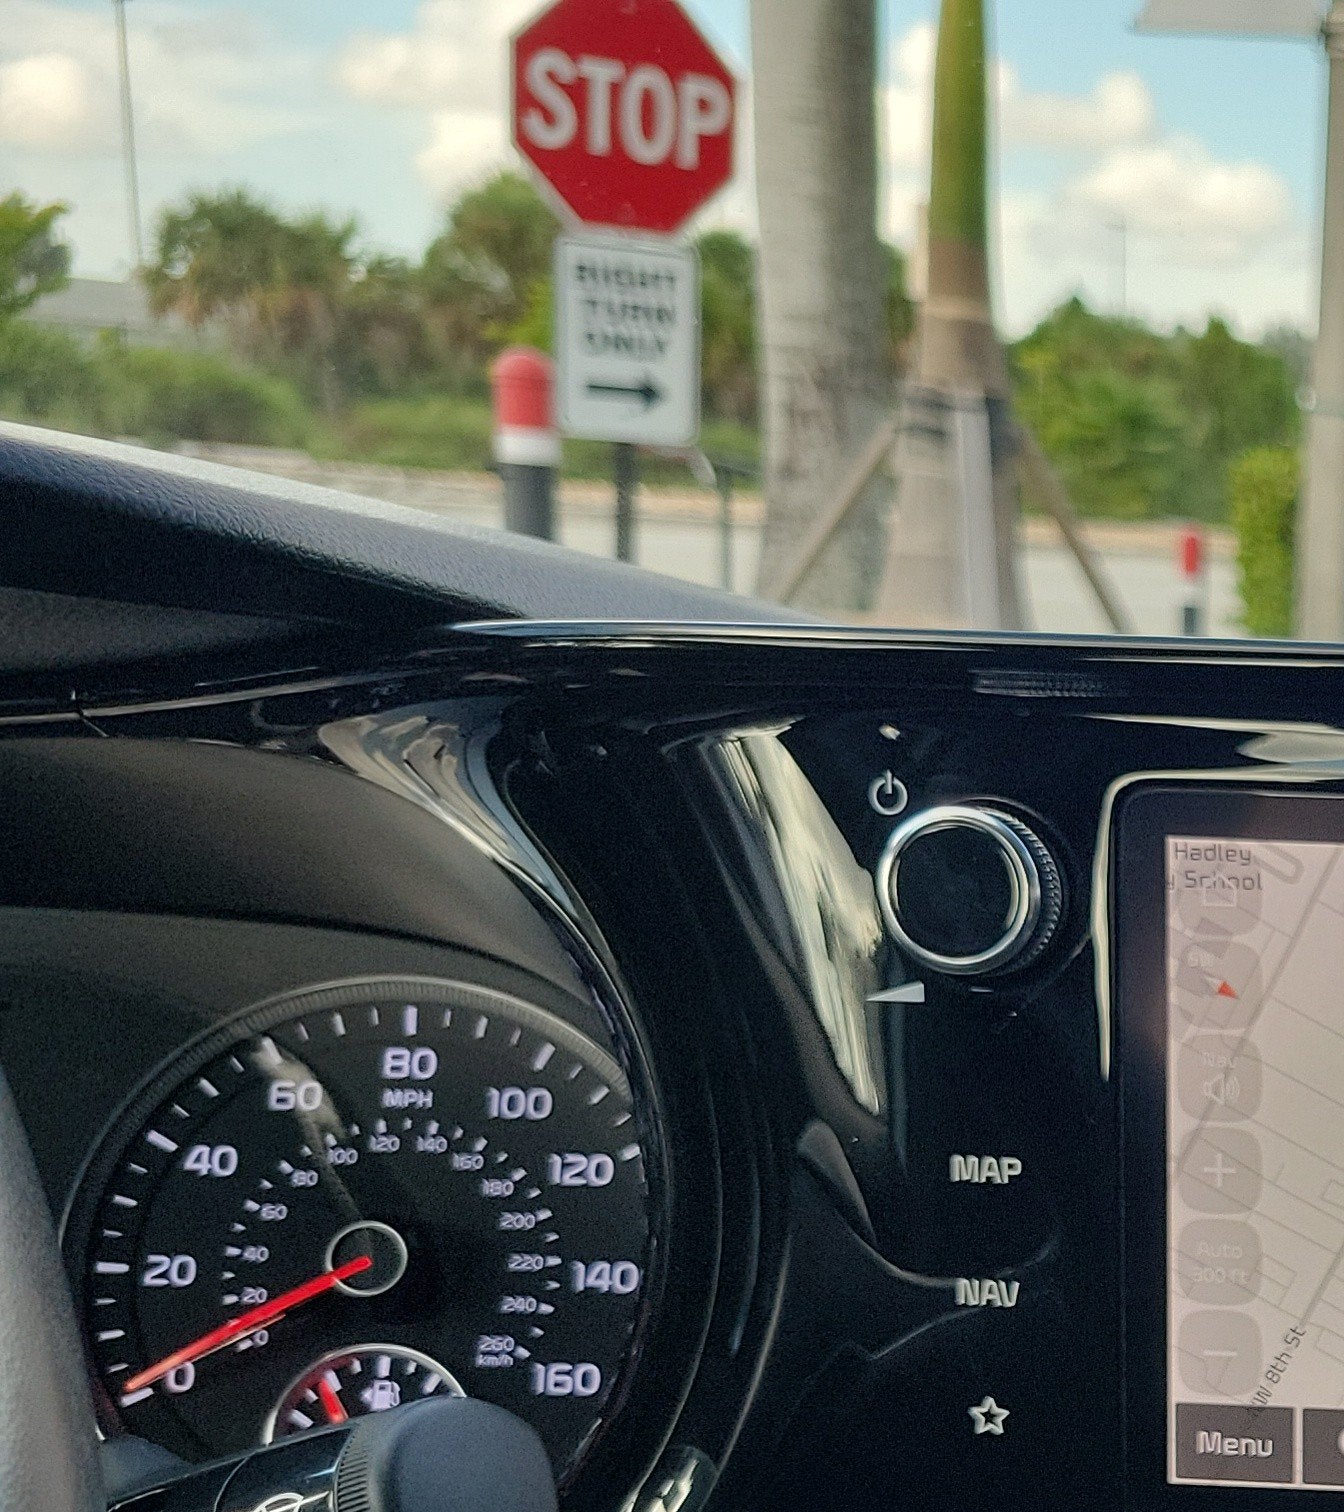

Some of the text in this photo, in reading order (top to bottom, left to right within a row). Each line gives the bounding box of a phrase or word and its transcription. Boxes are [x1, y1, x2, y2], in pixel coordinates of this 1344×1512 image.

[520, 47, 732, 171] STOP
[1174, 842, 1252, 866] Hadley
[1185, 869, 1263, 891] School
[383, 1046, 438, 1081] 80
[268, 1080, 323, 1111] 60
[382, 1088, 434, 1109] MPH
[487, 1085, 554, 1121] 100
[370, 1135, 401, 1154] 120
[184, 1144, 239, 1178] 40
[549, 1152, 615, 1187] 120
[949, 1154, 1022, 1184] MAP
[500, 1211, 536, 1231] 200
[143, 1254, 197, 1287] 20
[508, 1253, 544, 1272] 220
[569, 1260, 640, 1295] 140
[500, 1295, 537, 1314] 240
[955, 1277, 1020, 1308] NAV
[252, 1329, 269, 1346] 0
[475, 1353, 513, 1369] km/h
[1266, 1352, 1292, 1385] 8th
[1284, 1325, 1308, 1350] St
[164, 1362, 195, 1393] 0
[531, 1362, 601, 1397] 160
[1195, 1430, 1275, 1458] Menu
